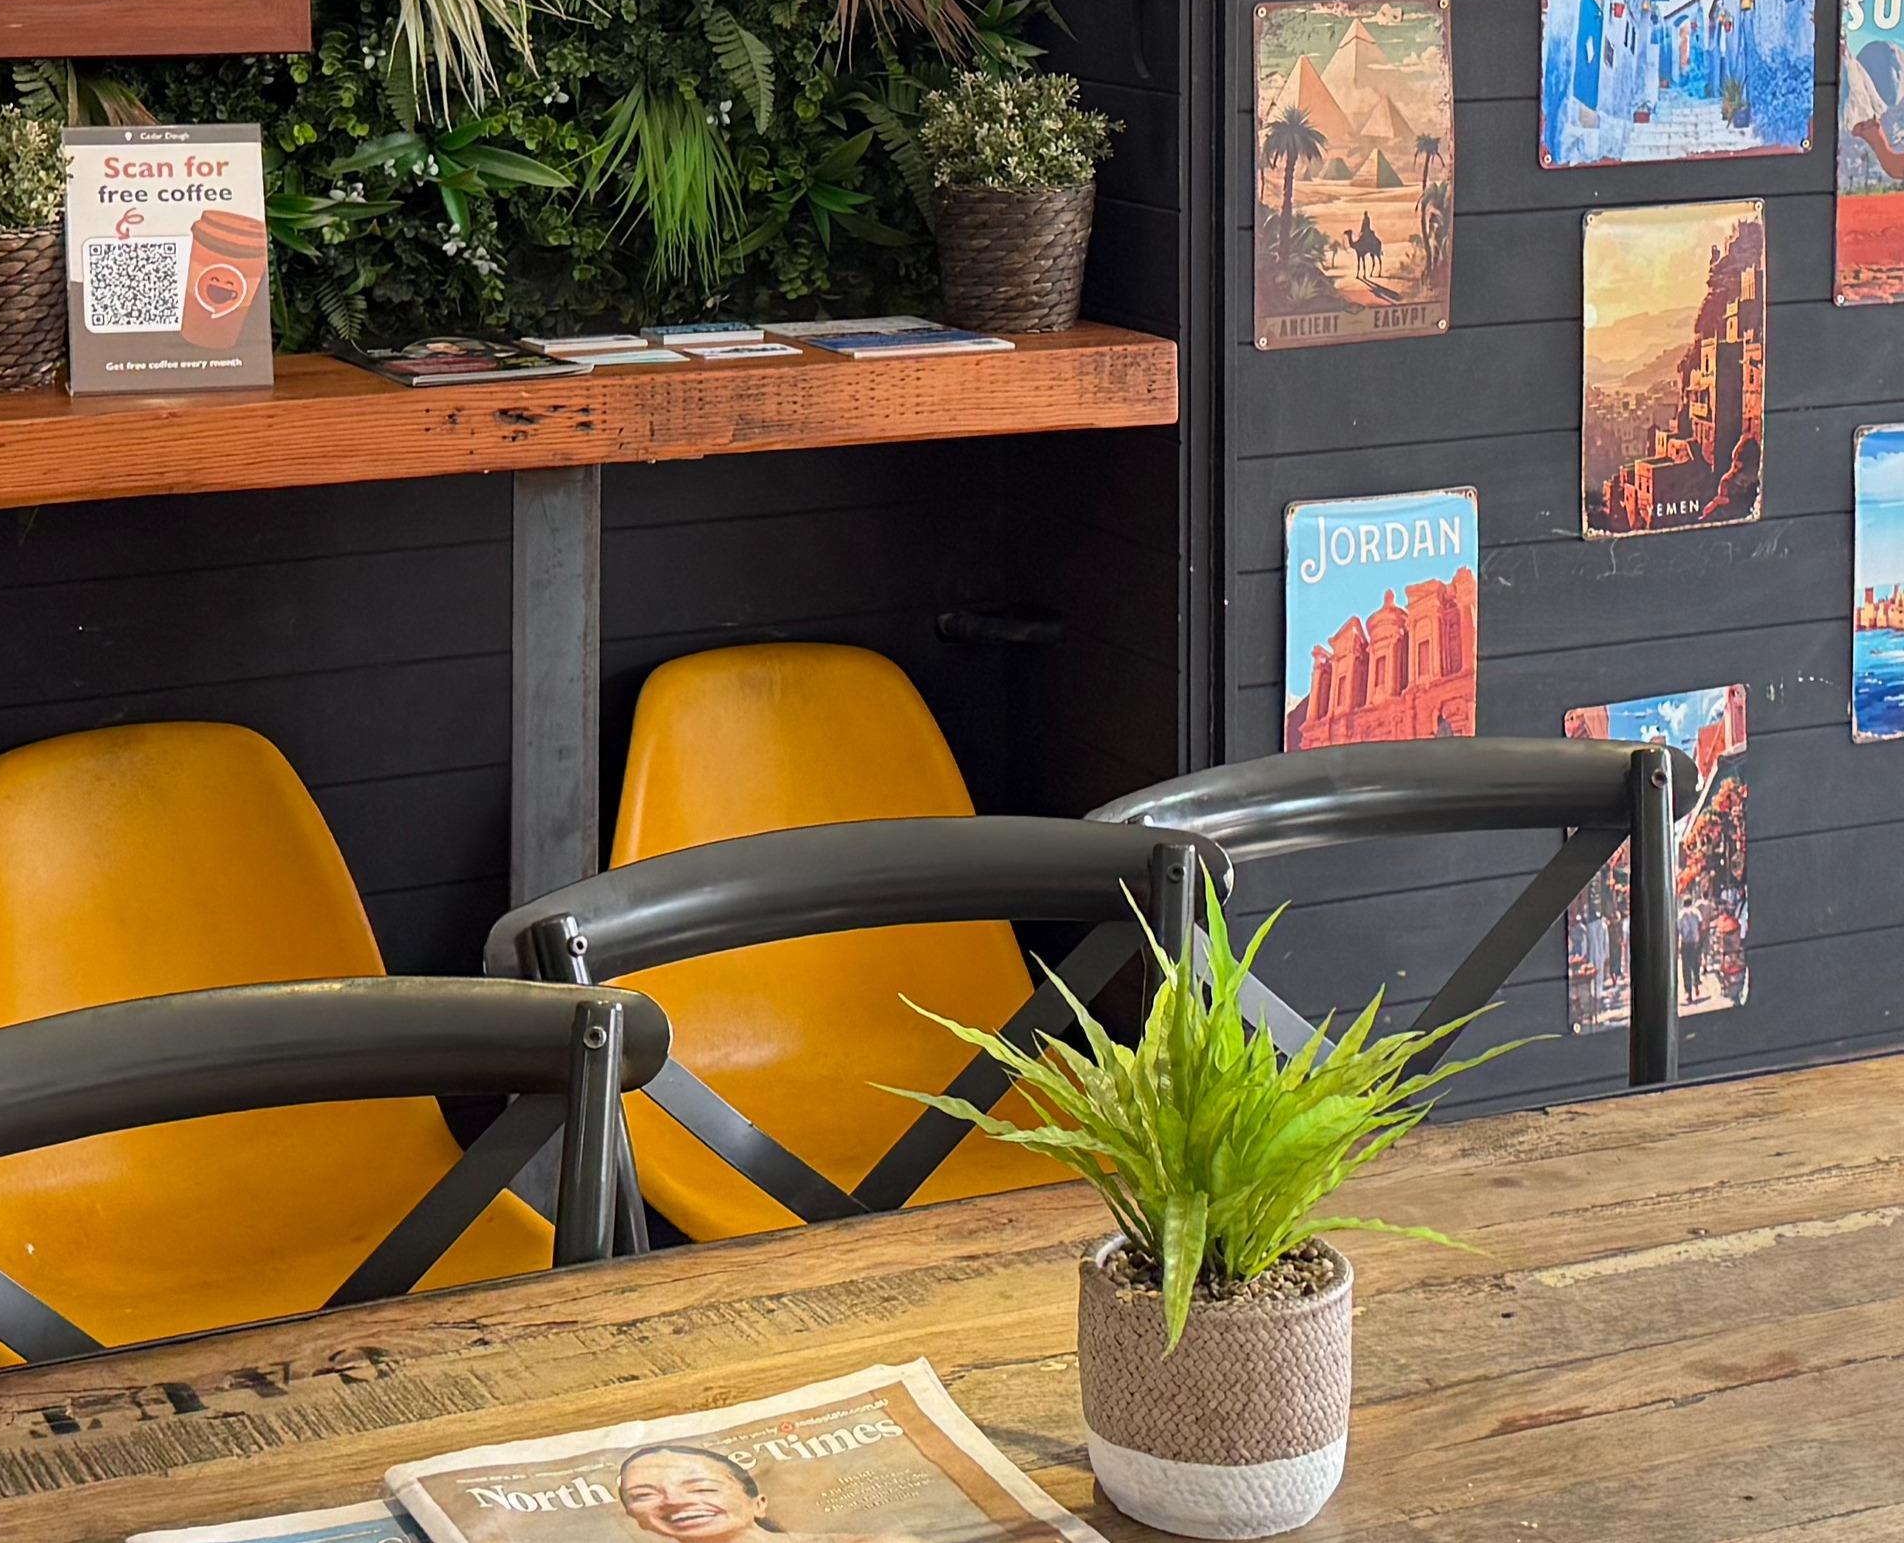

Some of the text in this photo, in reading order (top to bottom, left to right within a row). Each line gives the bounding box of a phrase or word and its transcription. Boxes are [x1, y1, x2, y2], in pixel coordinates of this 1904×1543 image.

[104, 156, 229, 179] Scan for
[98, 184, 233, 203] free coffee
[1280, 315, 1340, 338] ANCIENT
[127, 361, 146, 370] free
[148, 361, 179, 370] coffee
[180, 360, 208, 370] every
[1300, 516, 1461, 584] JORDAN
[466, 1477, 616, 1513] North
[753, 1418, 903, 1461] Times
